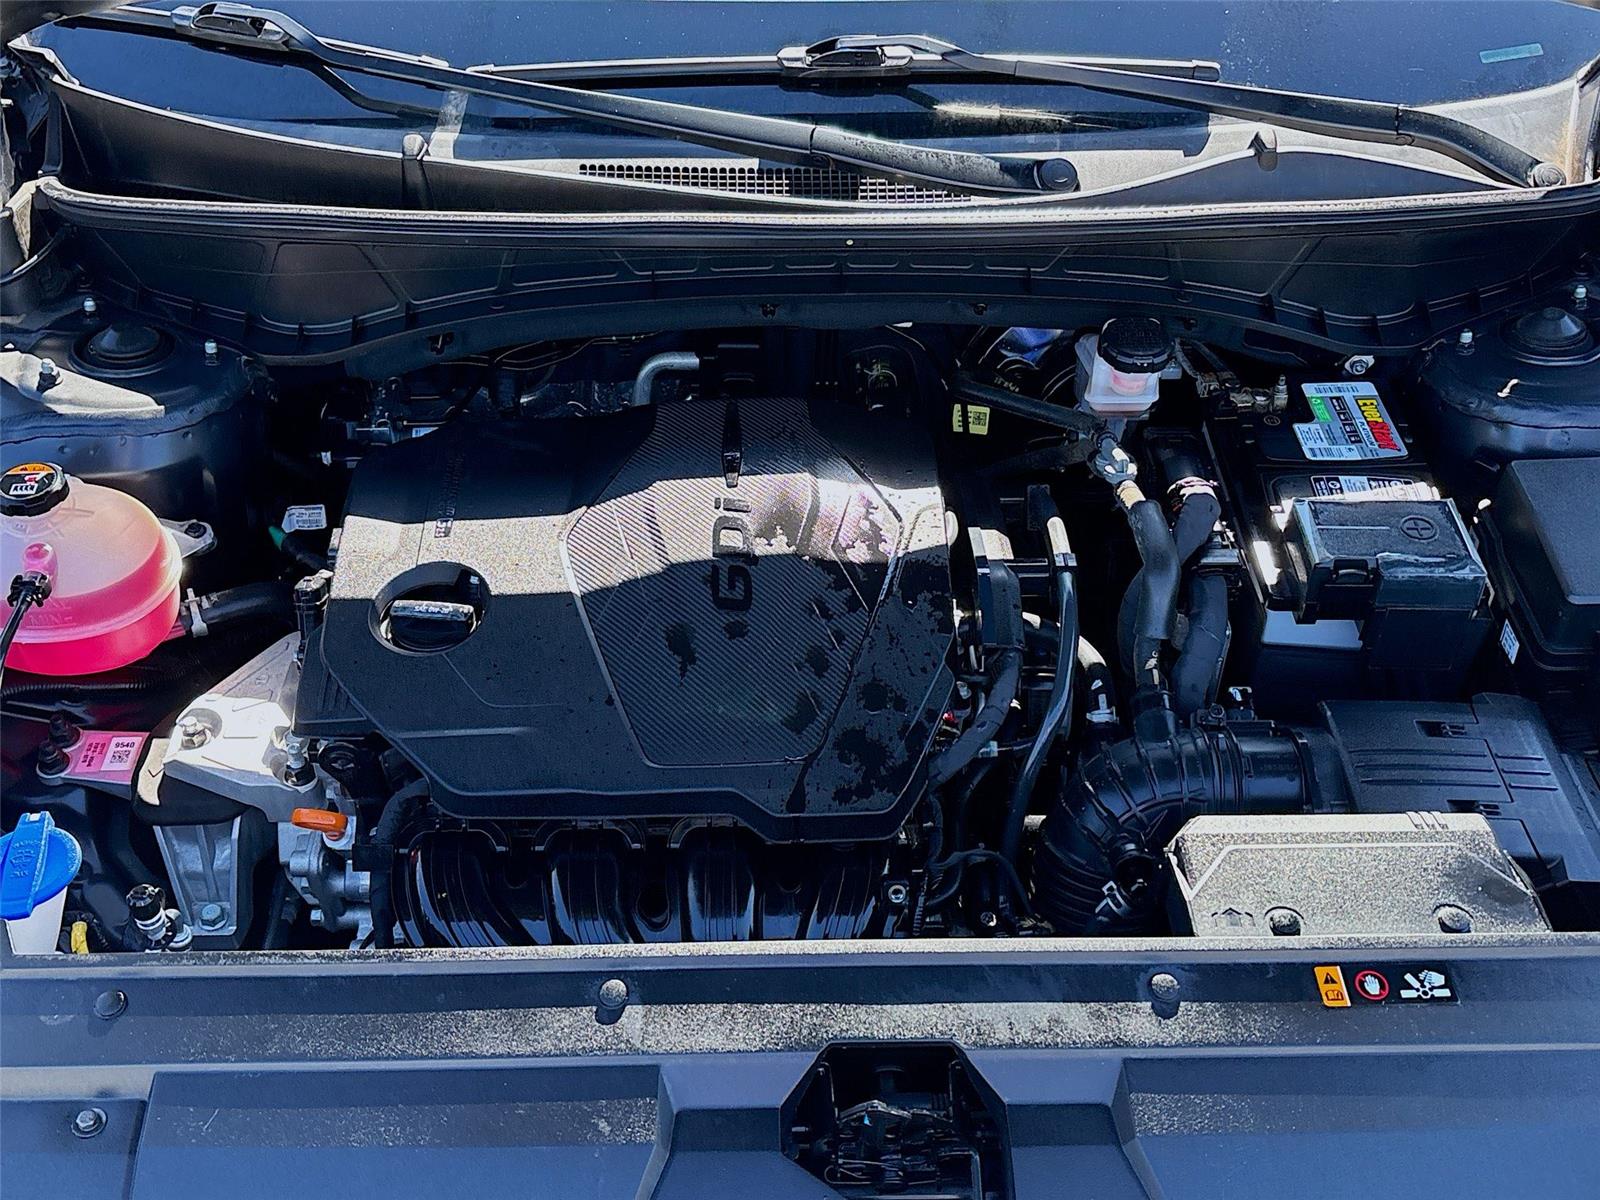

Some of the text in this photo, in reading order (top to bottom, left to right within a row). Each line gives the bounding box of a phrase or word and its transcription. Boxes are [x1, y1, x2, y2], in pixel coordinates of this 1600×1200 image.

[1357, 398, 1399, 451] EverStart
[1358, 420, 1376, 447] PLATINUM
[114, 741, 136, 749] 9540
